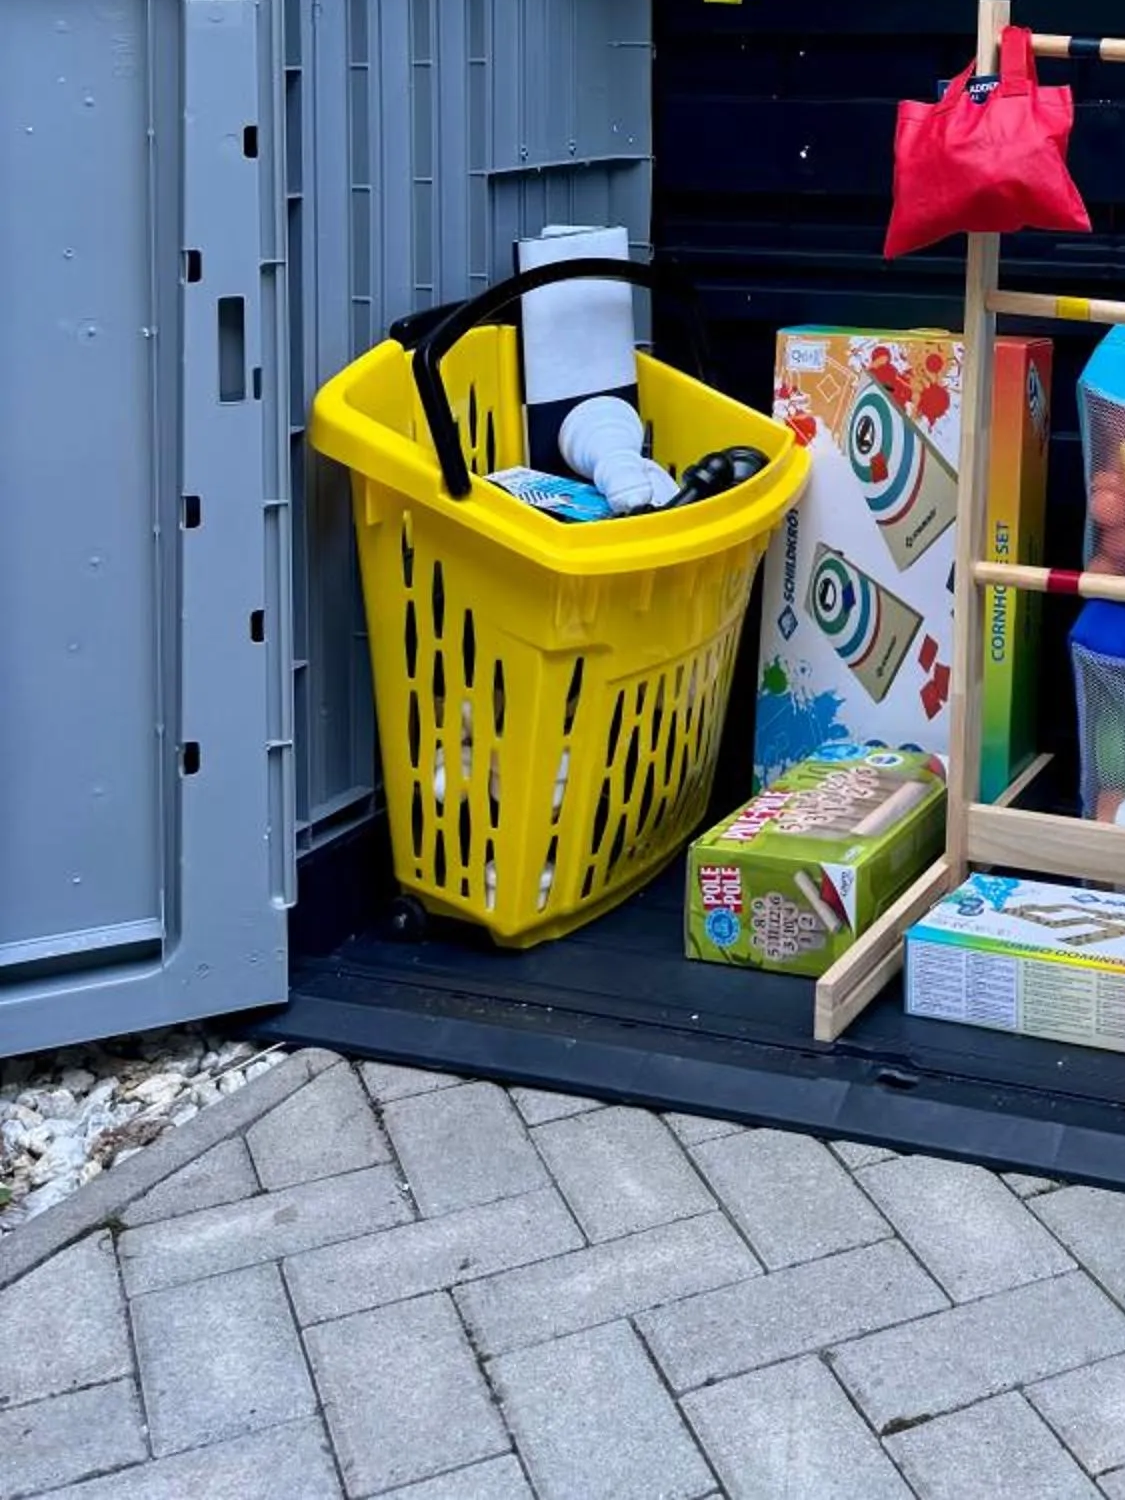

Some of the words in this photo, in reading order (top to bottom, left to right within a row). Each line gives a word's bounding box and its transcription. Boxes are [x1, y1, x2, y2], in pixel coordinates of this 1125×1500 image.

[996, 521, 1009, 554] SET
[991, 558, 1009, 662] CORNHO
[701, 867, 722, 905] POLE
